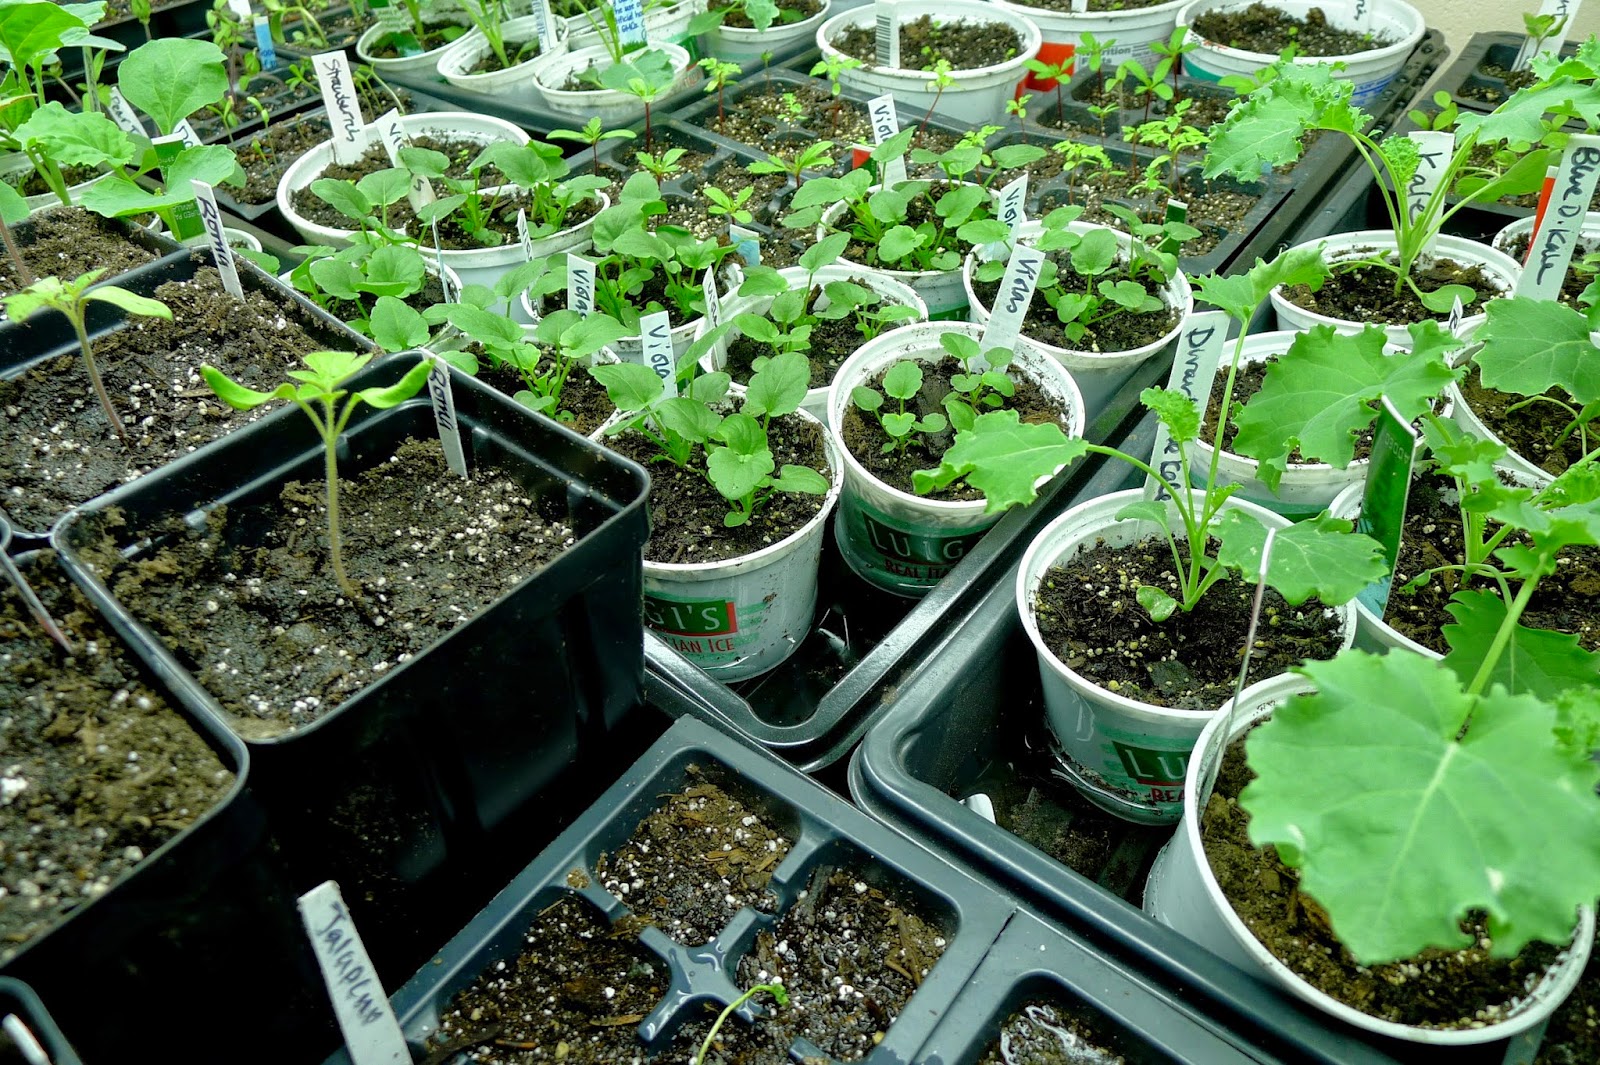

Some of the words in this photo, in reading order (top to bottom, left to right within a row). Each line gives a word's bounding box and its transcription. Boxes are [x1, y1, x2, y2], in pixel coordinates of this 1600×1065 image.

[868, 520, 963, 561] LUIG
[644, 601, 720, 630] GI'S
[1125, 749, 1186, 779] LU
